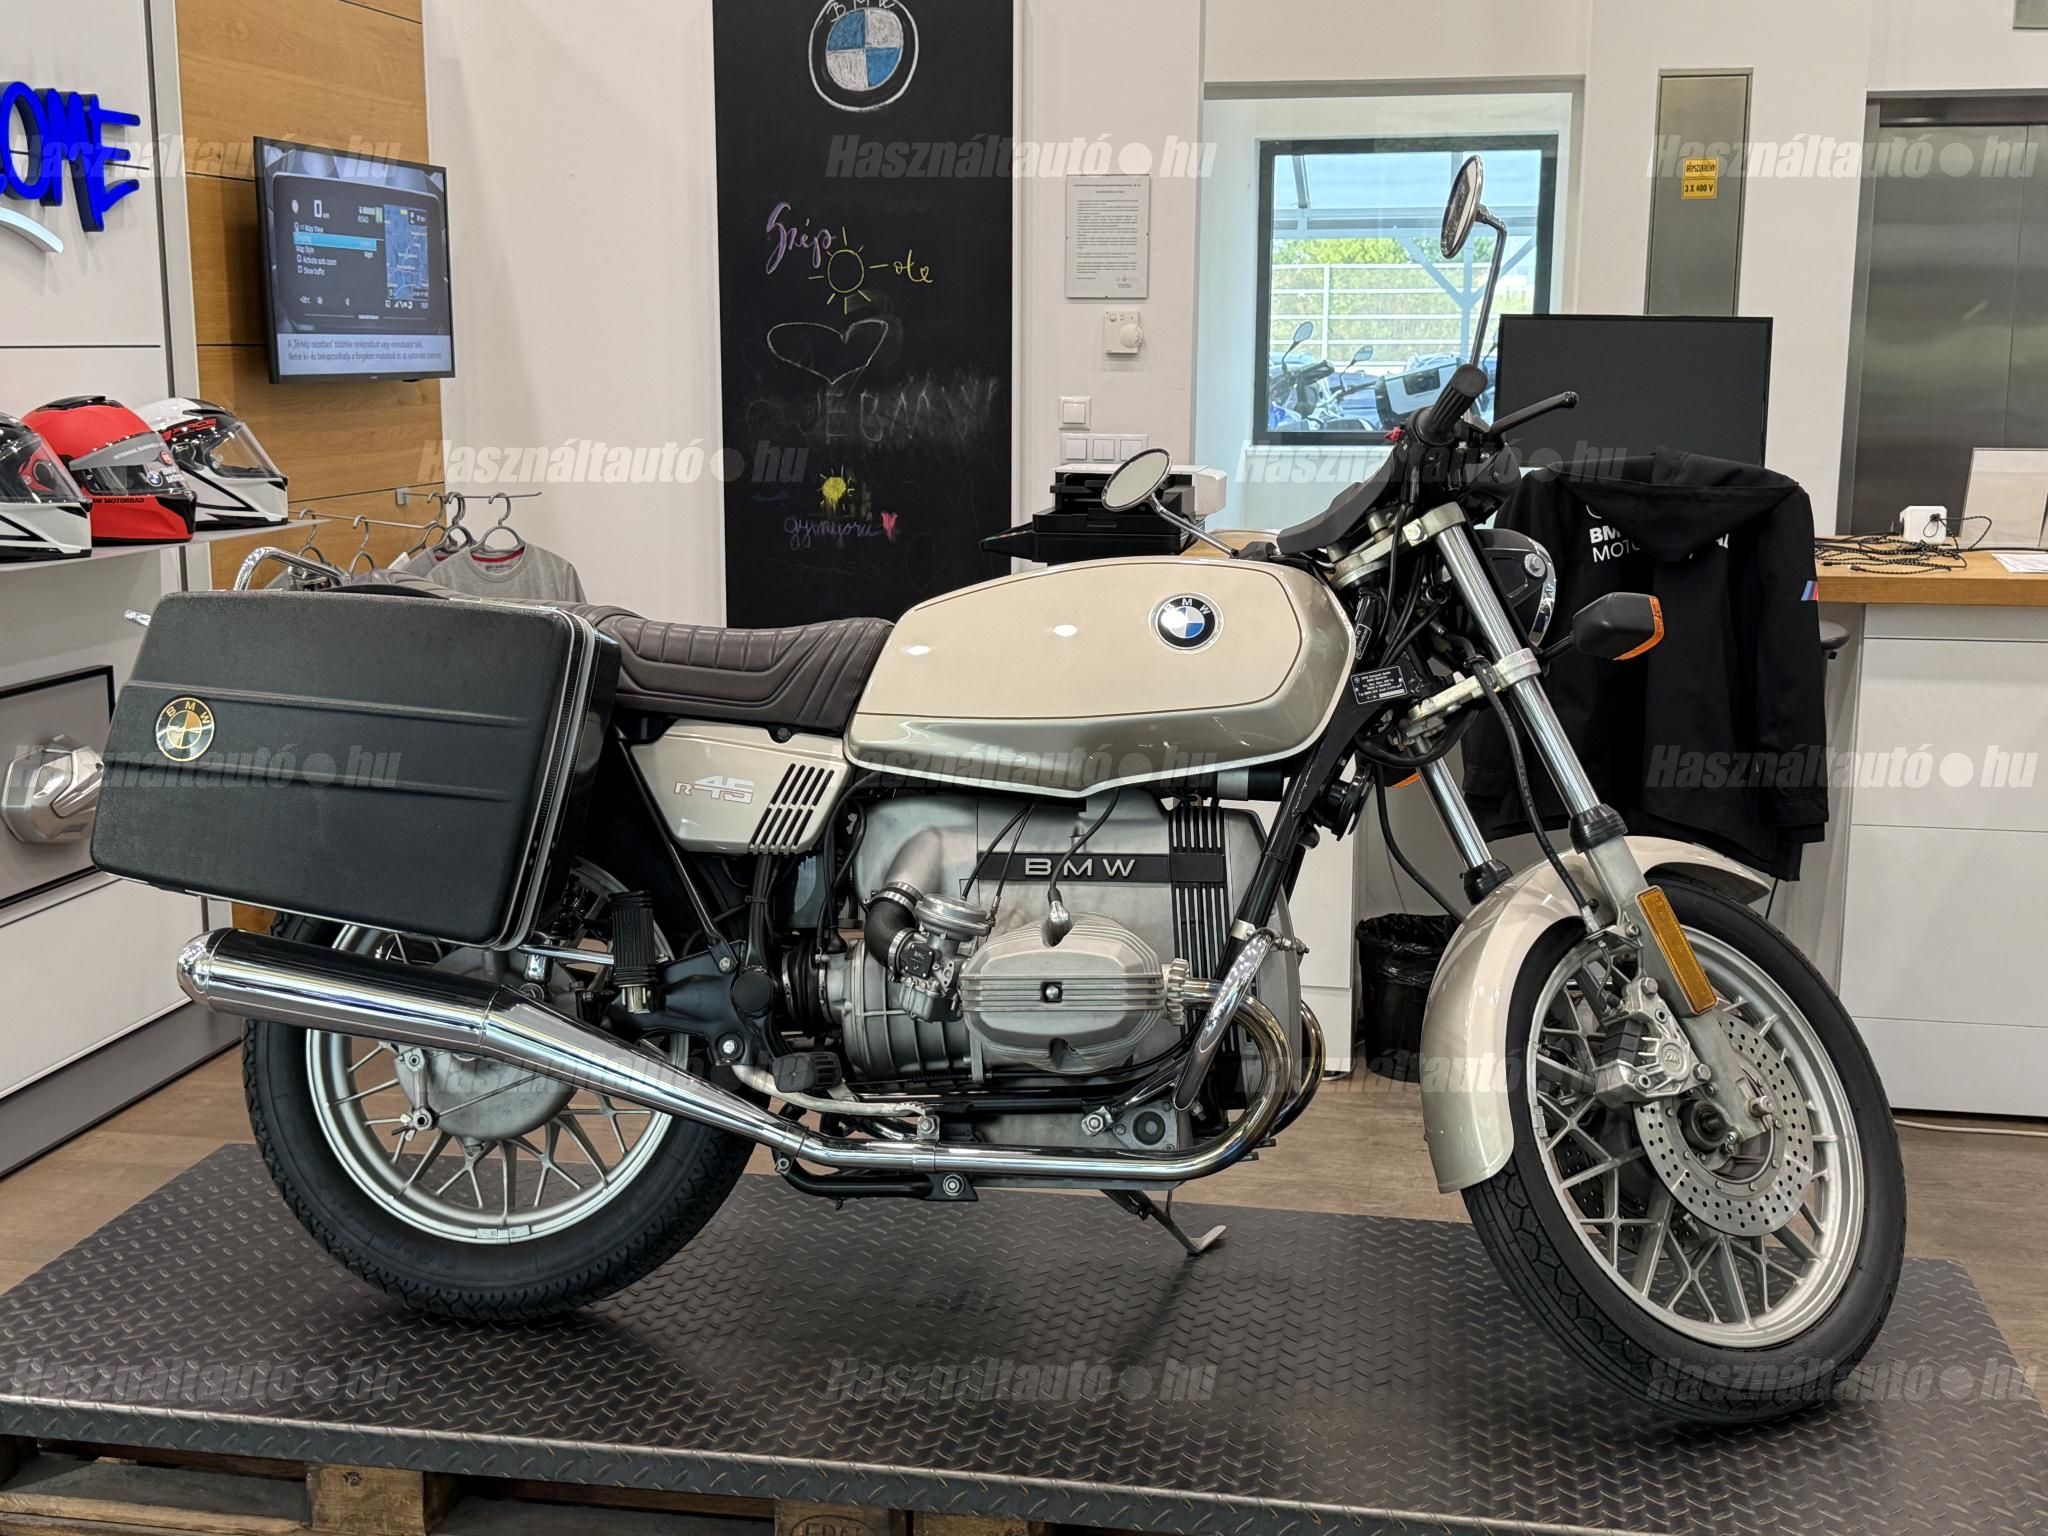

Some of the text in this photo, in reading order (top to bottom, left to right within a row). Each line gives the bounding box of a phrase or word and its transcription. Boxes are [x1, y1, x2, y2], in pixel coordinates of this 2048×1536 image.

[1696, 184, 1708, 192] 400
[1709, 184, 1714, 192] V
[766, 202, 836, 274] Szép
[1163, 598, 1211, 615] BMW
[166, 701, 211, 724] BMW
[674, 775, 754, 804] R 45
[1025, 858, 1136, 877] BMW
